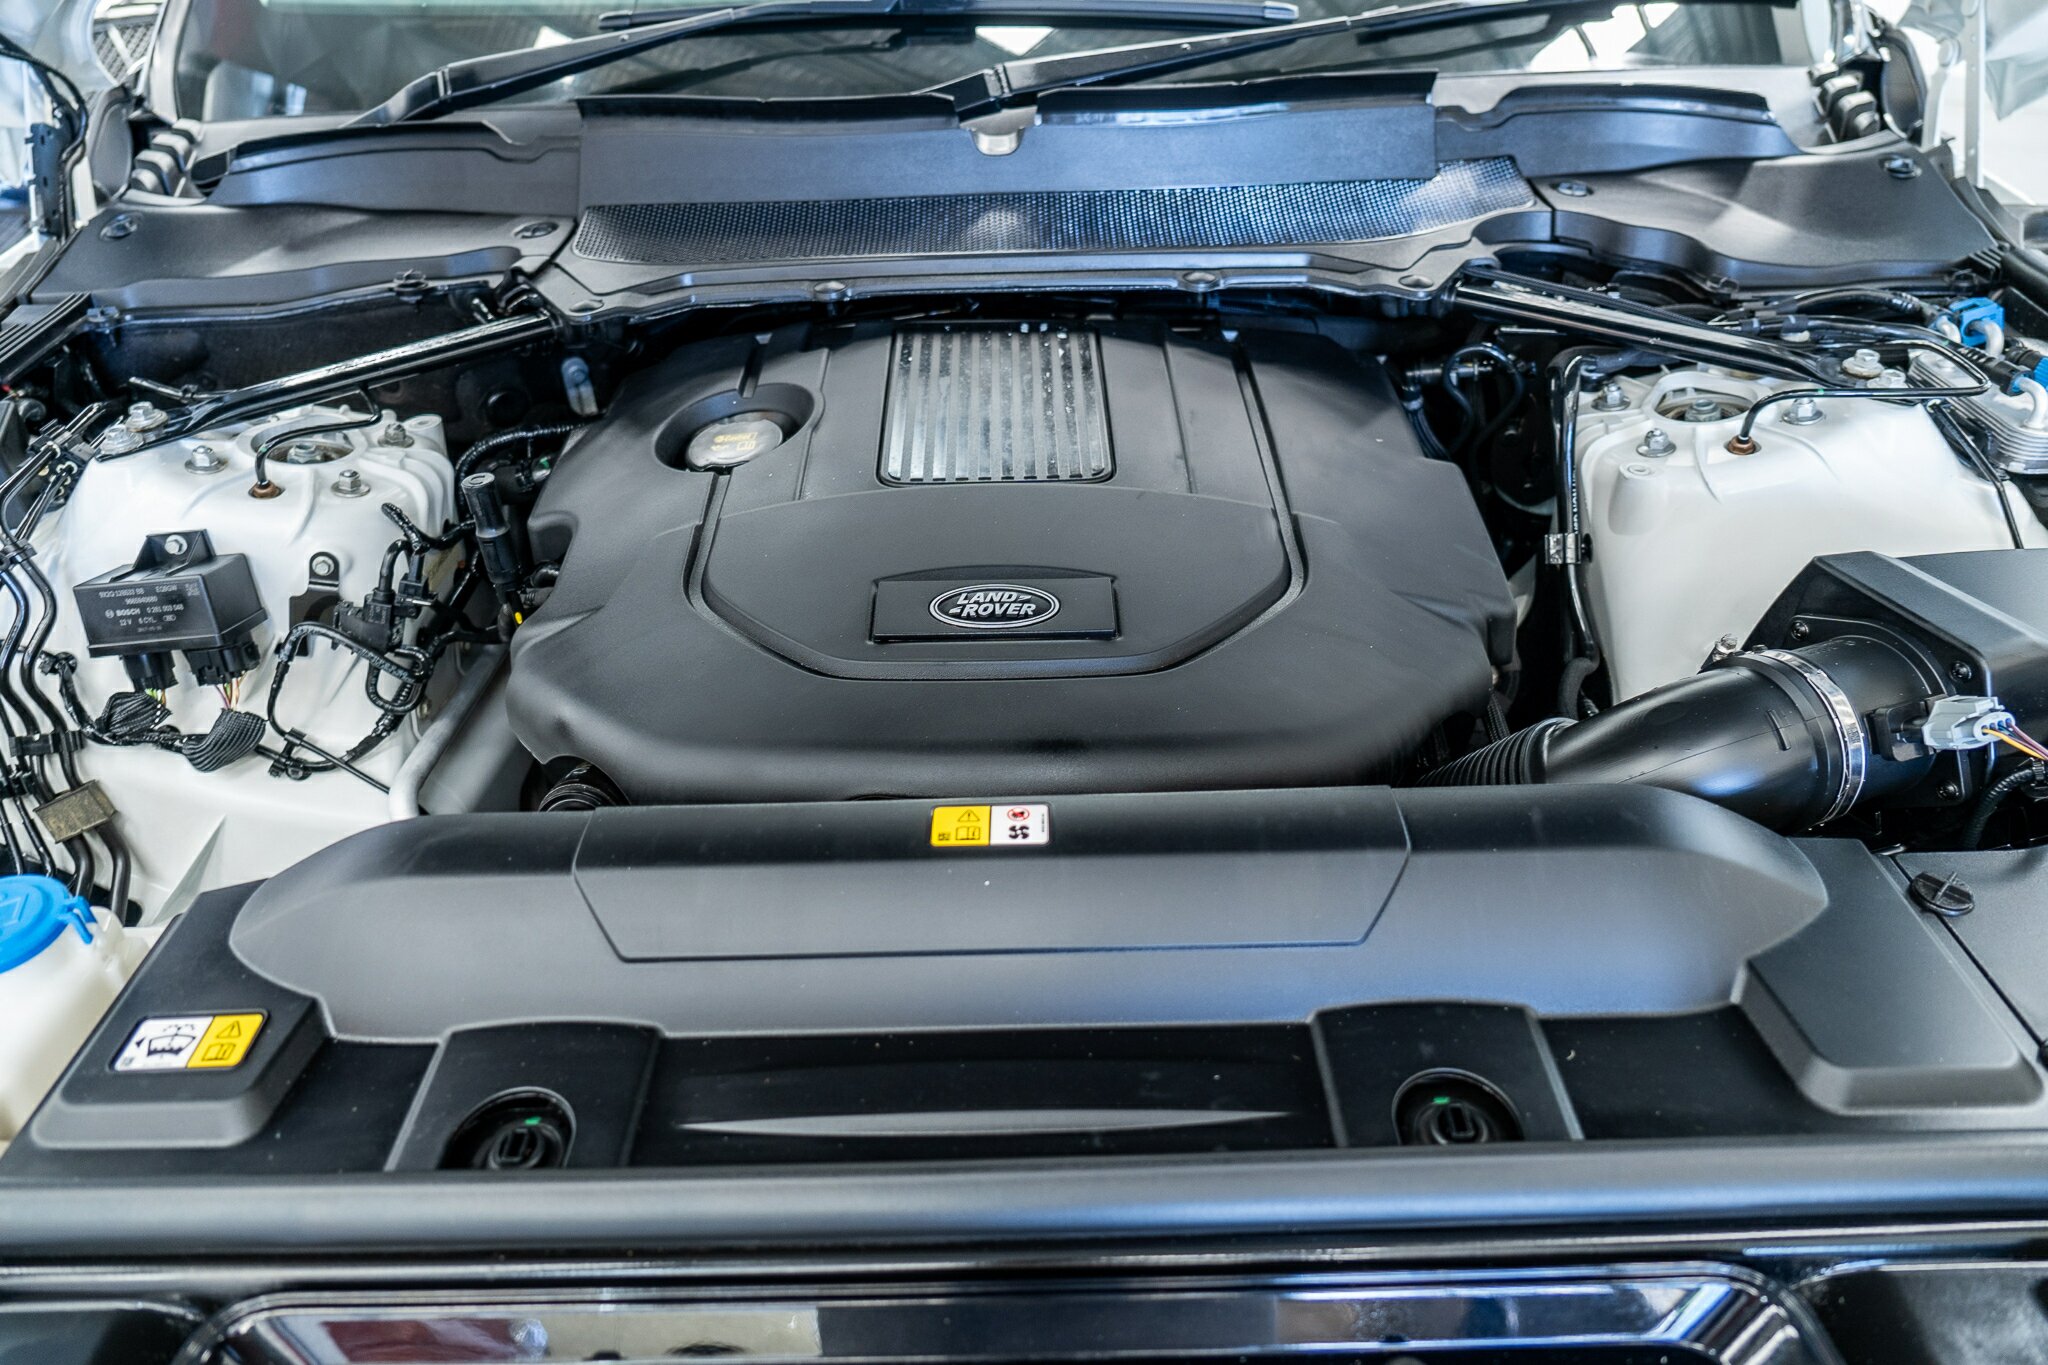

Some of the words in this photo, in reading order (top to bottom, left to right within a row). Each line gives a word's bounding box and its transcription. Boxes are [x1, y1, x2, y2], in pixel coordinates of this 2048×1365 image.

[956, 591, 1018, 604] LAND
[115, 608, 141, 616] BOSCH
[961, 603, 1036, 617] ROVER
